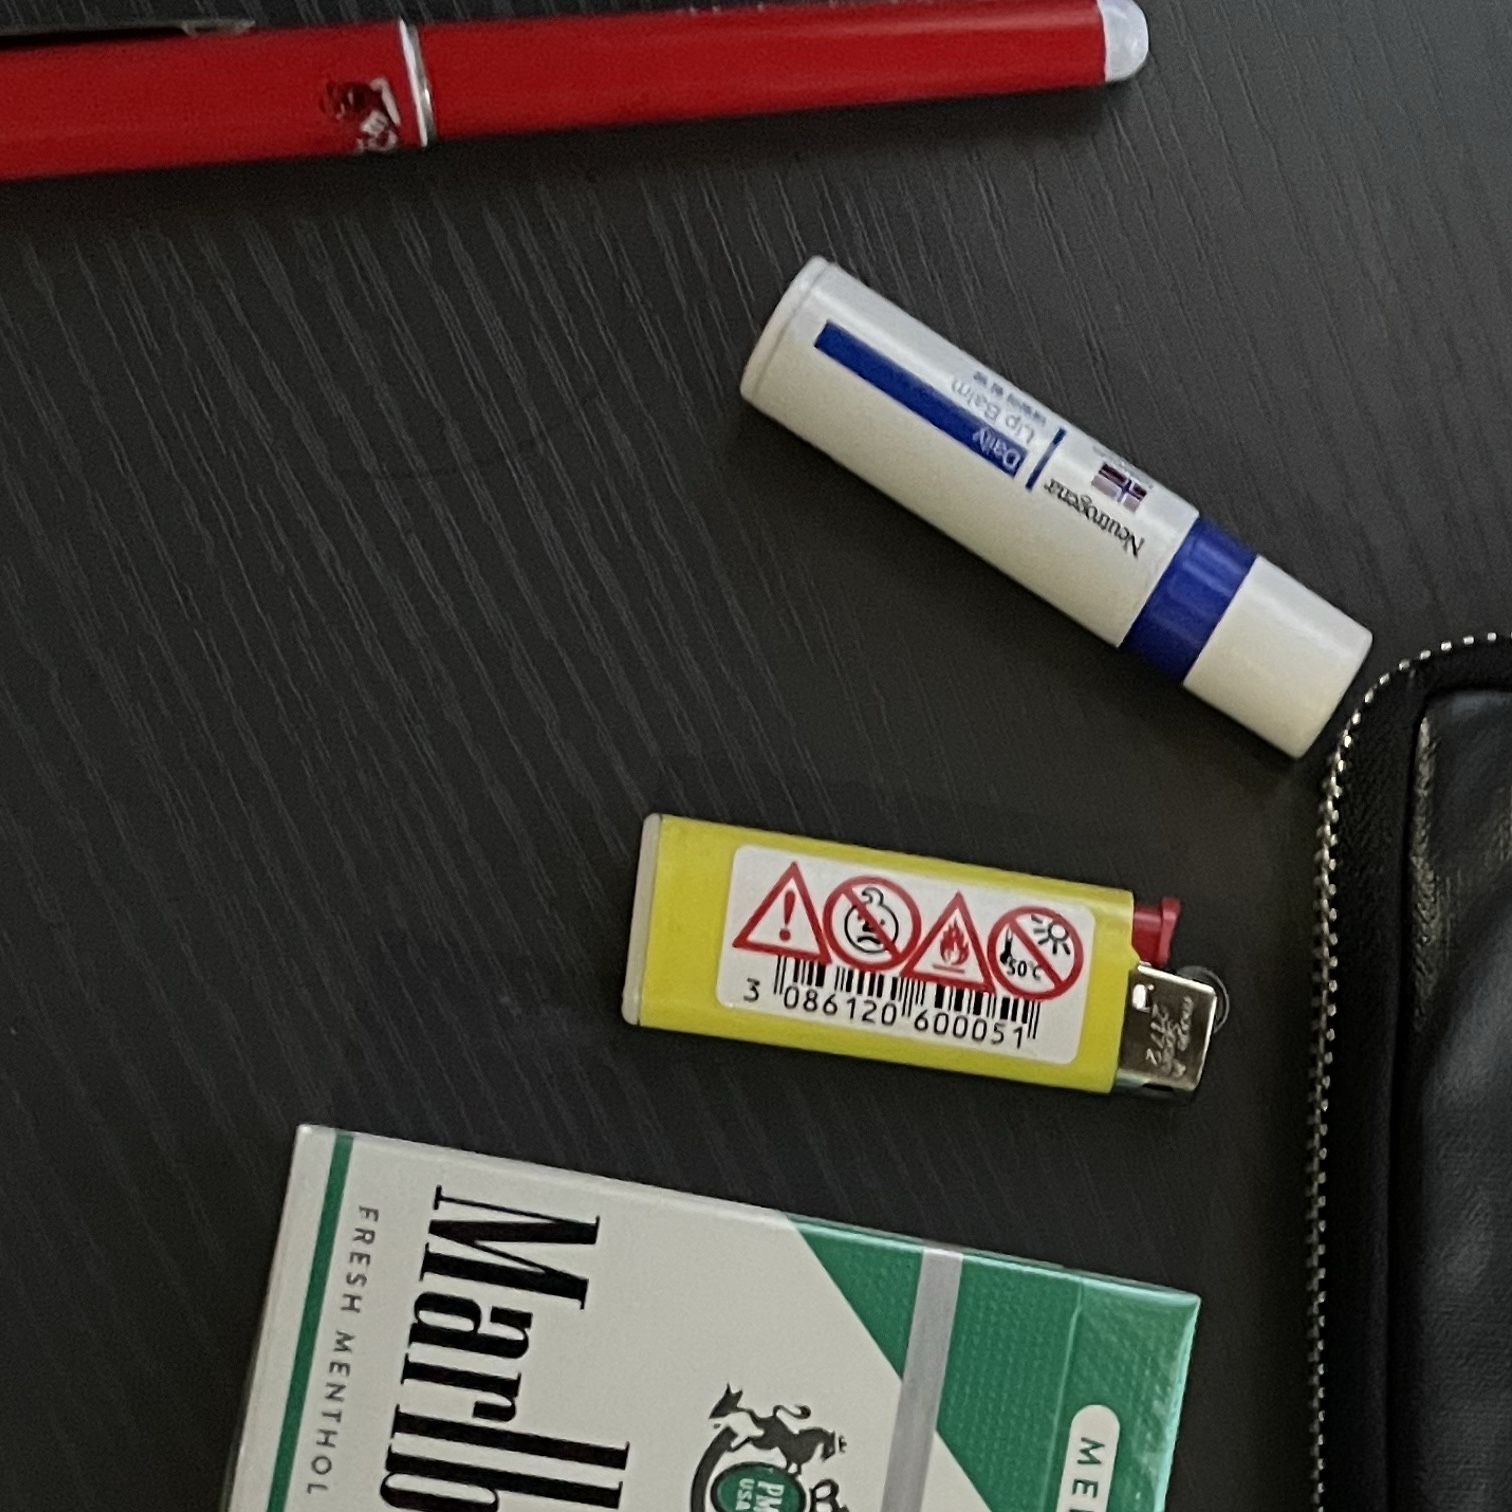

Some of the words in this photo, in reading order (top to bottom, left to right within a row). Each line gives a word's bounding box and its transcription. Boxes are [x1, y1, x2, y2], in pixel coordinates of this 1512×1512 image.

[952, 378, 1002, 423] Balm
[971, 426, 1023, 471] Daily
[1005, 413, 1035, 444] Lip
[743, 977, 761, 1002] 3
[783, 985, 898, 1026] 086120
[914, 1009, 1023, 1049] 600051
[340, 1205, 379, 1313] FRESH
[307, 1331, 355, 1495] MENTHOL
[735, 1477, 755, 1511] USA
